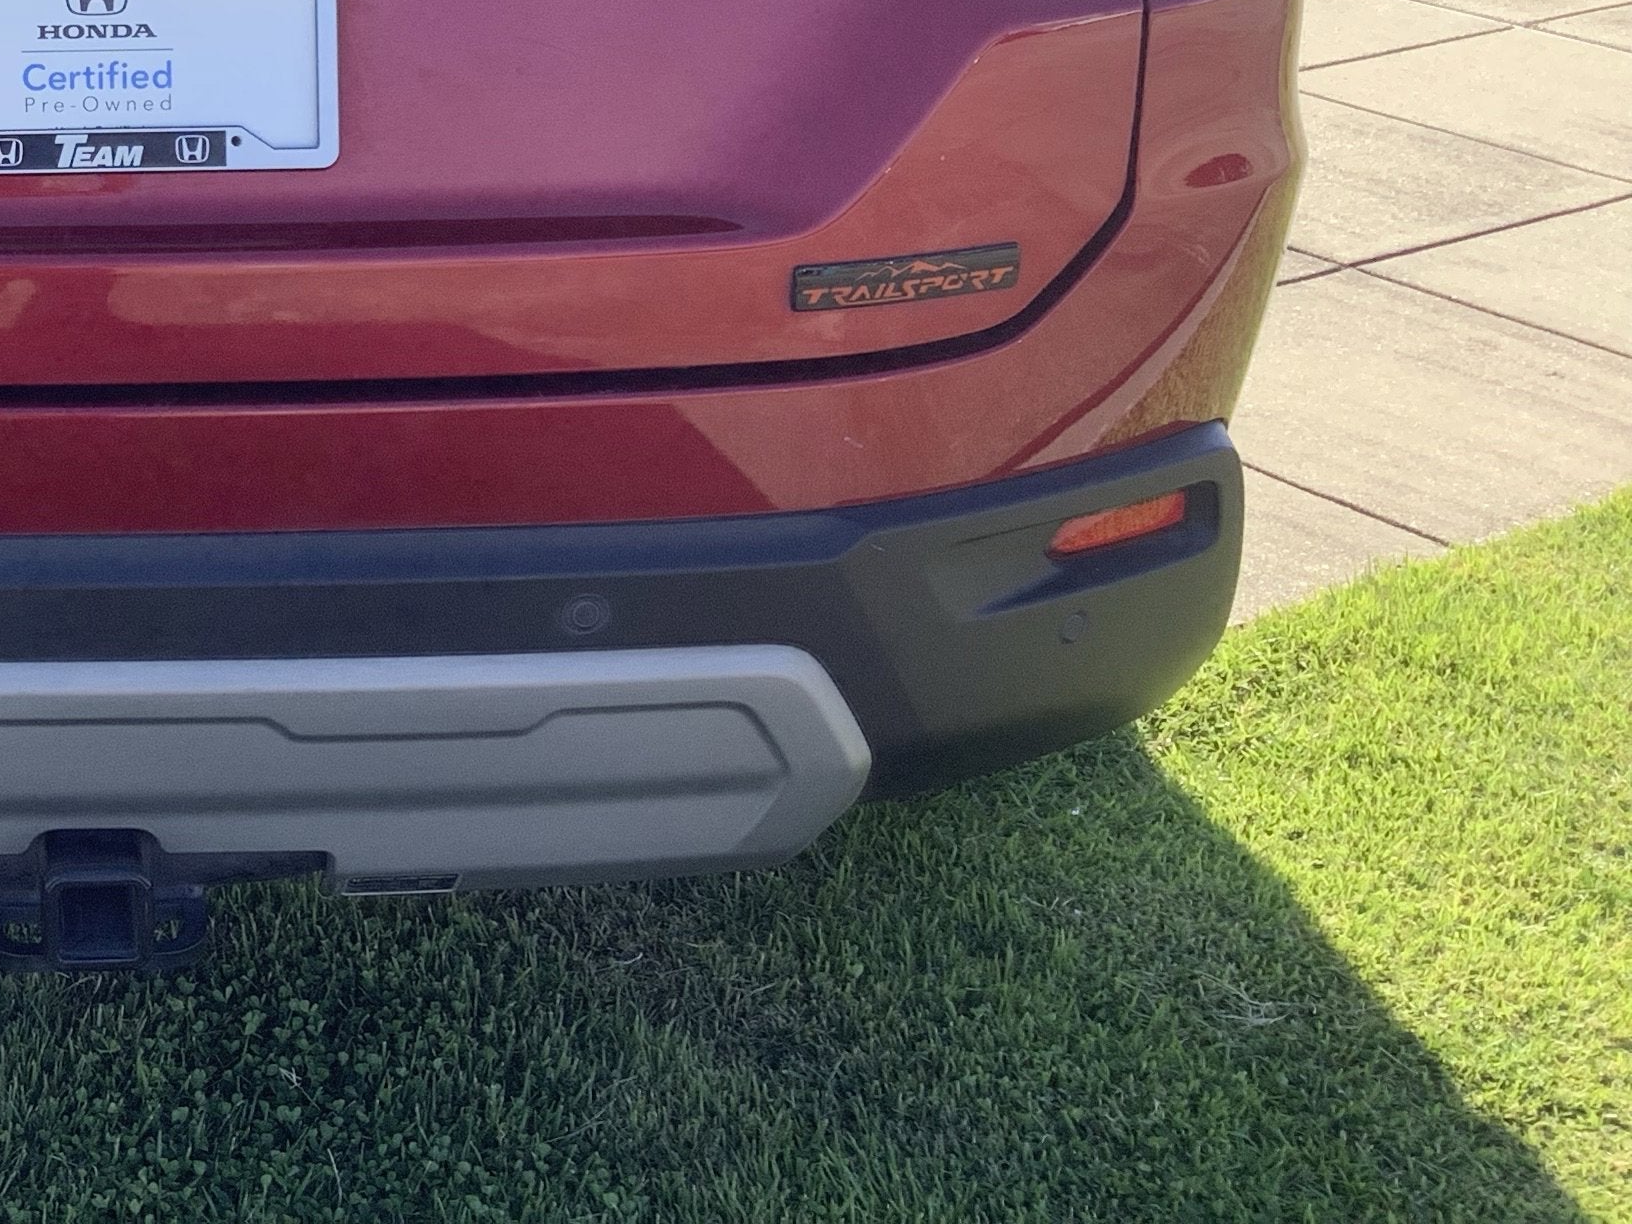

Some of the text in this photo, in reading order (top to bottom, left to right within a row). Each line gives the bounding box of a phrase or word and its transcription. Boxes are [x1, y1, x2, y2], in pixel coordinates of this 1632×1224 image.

[37, 24, 157, 39] HONDA
[22, 60, 173, 91] Certified
[24, 93, 173, 113] Pre-Owned
[54, 134, 144, 168] TEAM
[803, 266, 1014, 306] TRAILSPORT
